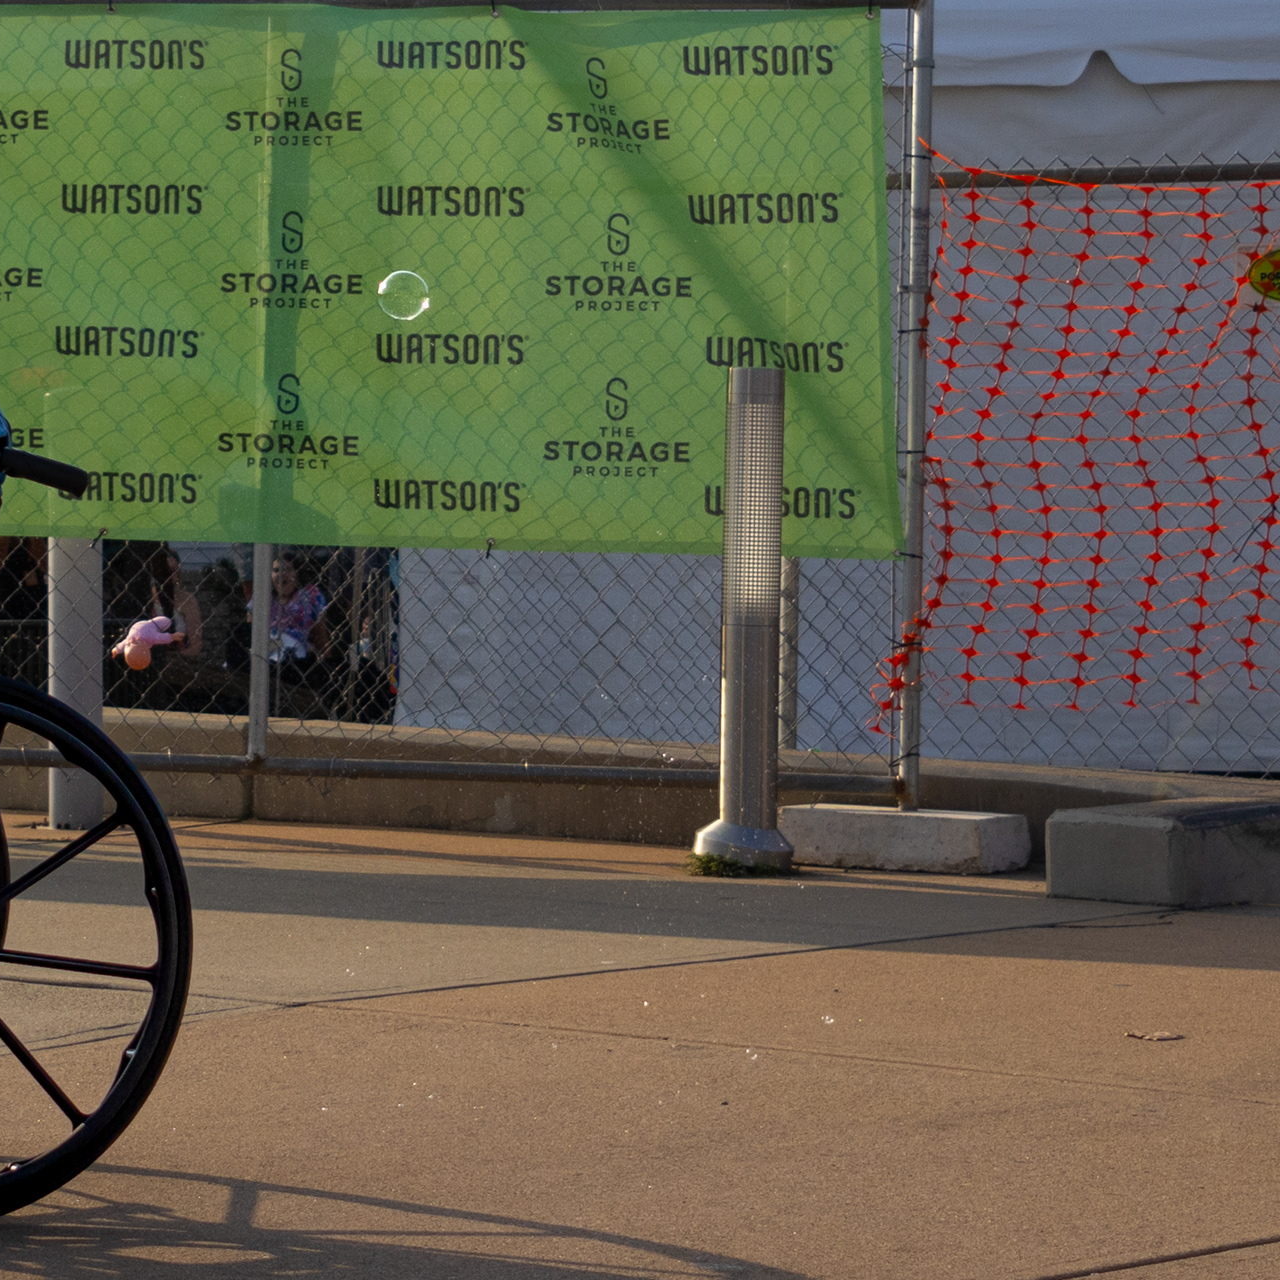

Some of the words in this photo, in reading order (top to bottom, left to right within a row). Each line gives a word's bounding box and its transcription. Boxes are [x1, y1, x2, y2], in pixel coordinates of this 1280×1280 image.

[65, 40, 204, 69] WATSON'S
[378, 40, 525, 70] WATSON'S
[683, 45, 832, 75] WATSON'S
[277, 97, 309, 107] THE
[591, 103, 616, 115] THE
[226, 111, 362, 131] STORAGE
[546, 112, 670, 140] STORAGE
[255, 135, 332, 146] PROJECT
[577, 137, 641, 154] PROJECT
[62, 184, 202, 214] WATSON'S
[378, 186, 524, 217] WATSON'S
[688, 193, 838, 225] WATSON'S
[275, 259, 308, 269] THE
[601, 261, 635, 272] THE
[221, 273, 362, 294] STORAGE
[546, 276, 691, 297] STORAGE
[250, 297, 331, 309] PROJECT
[576, 300, 660, 311] PROJECT
[56, 326, 198, 358] WATSON'S
[376, 334, 523, 365] WATSON'S
[706, 336, 844, 373] WATSON'S
[271, 420, 304, 431] THE
[600, 427, 634, 437] THE
[218, 433, 358, 456] STORAGE
[544, 441, 690, 462] STORAGE
[248, 457, 328, 469] PROJECT
[573, 466, 658, 477] PROJECT
[374, 479, 519, 512] WATSON'S
[705, 485, 855, 519] WSON'S
